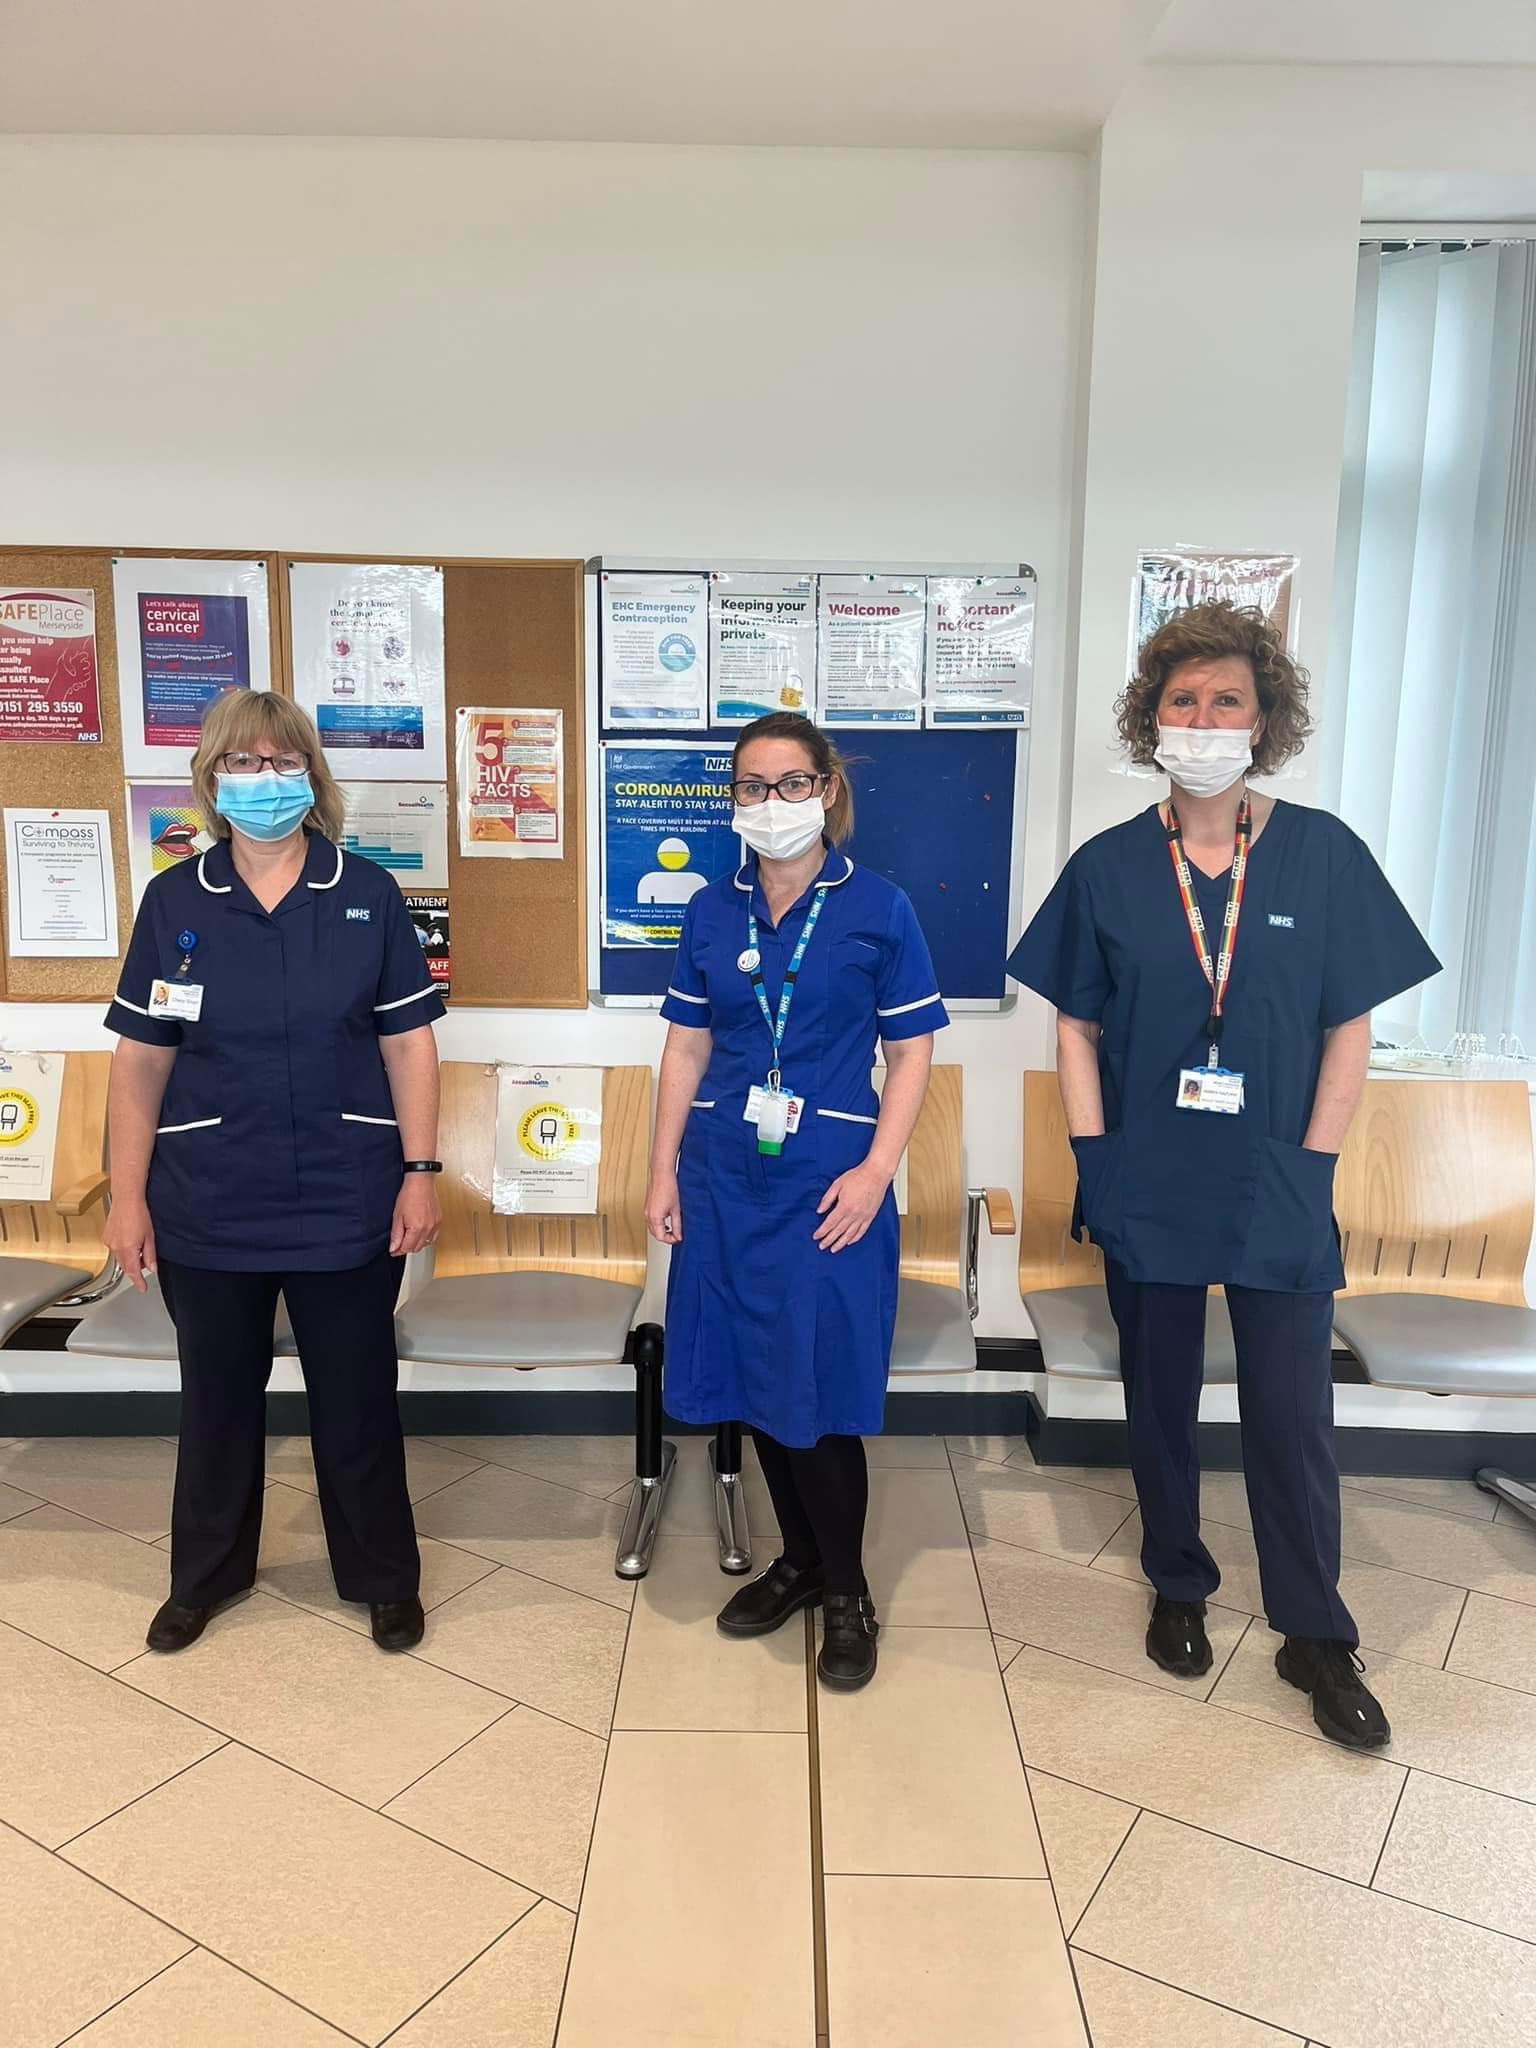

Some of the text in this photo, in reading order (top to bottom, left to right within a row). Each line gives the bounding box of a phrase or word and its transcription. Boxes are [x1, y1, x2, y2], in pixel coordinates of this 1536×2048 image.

[178, 601, 199, 609] about
[612, 602, 696, 614] EHC Emergency
[721, 599, 807, 613] Keeping your
[828, 603, 901, 616] Welcome
[937, 604, 1016, 616] Iortant
[0, 604, 84, 622] AFEPlace
[147, 608, 200, 622] cervical
[330, 608, 345, 617] the
[612, 613, 688, 625] Contraception
[39, 621, 84, 631] Merseyside
[147, 622, 200, 633] cancer
[721, 628, 766, 641] private
[2, 637, 54, 646] you need help
[27, 701, 50, 713] 295
[53, 701, 83, 713] 3550
[78, 732, 98, 741] NHS
[475, 722, 504, 766] 5
[707, 758, 733, 770] NHS
[478, 766, 511, 783] HIV
[476, 783, 531, 798] FACTS
[614, 782, 732, 798] CORONAVIRUS
[615, 799, 733, 810] STAY ALERT TO STAY SAFE
[22, 839, 95, 849] Surviving to Thriving
[405, 897, 448, 907] ATMENT
[346, 908, 370, 920] NHS
[1268, 914, 1295, 927] NHS
[427, 961, 449, 971] AFF
[775, 1020, 785, 1040] NHS
[10, 1092, 23, 1100] THIS
[522, 1116, 532, 1138] PLEASE
[530, 1106, 547, 1119] LEAVE
